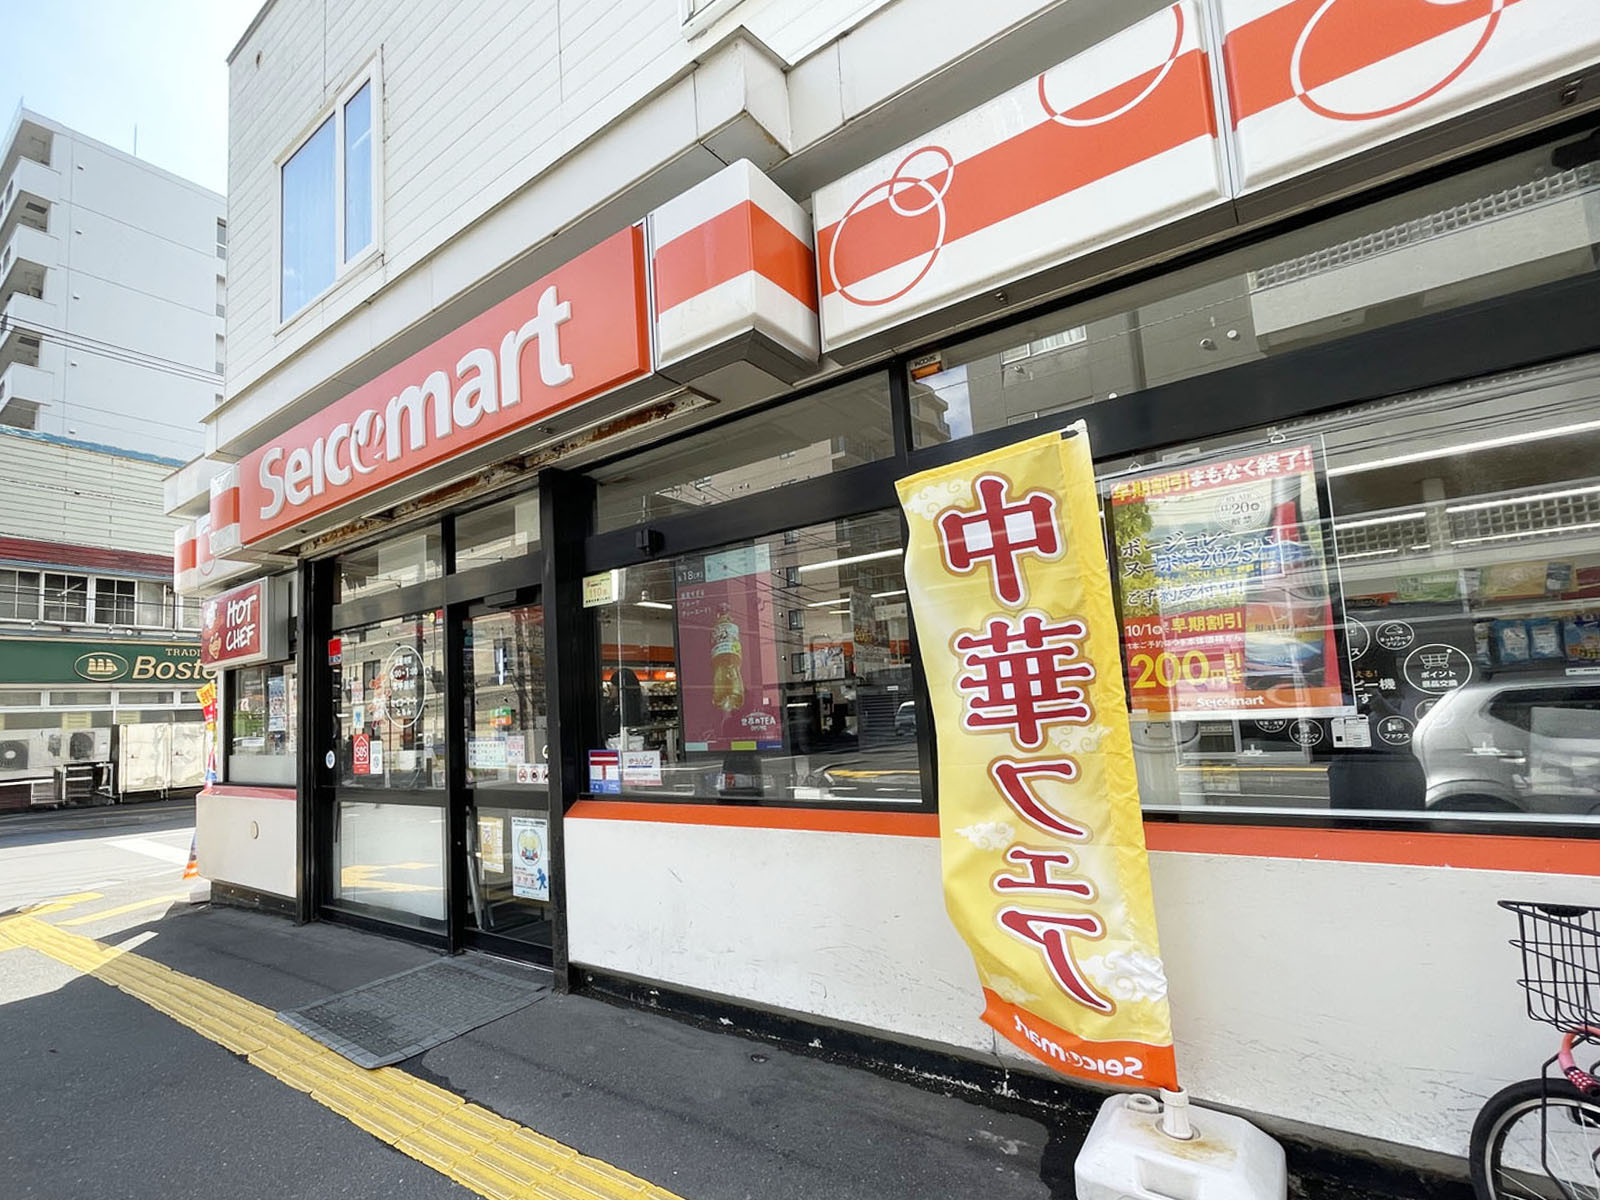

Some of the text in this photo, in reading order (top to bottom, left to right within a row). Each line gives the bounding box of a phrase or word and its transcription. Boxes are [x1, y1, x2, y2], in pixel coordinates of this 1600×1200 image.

[259, 285, 574, 520] Seicomart
[227, 594, 257, 628] HOT
[1171, 612, 1242, 633] 早期割引
[226, 623, 256, 651] CHEF
[165, 648, 202, 656] TRADI
[1421, 670, 1456, 678] ポイント
